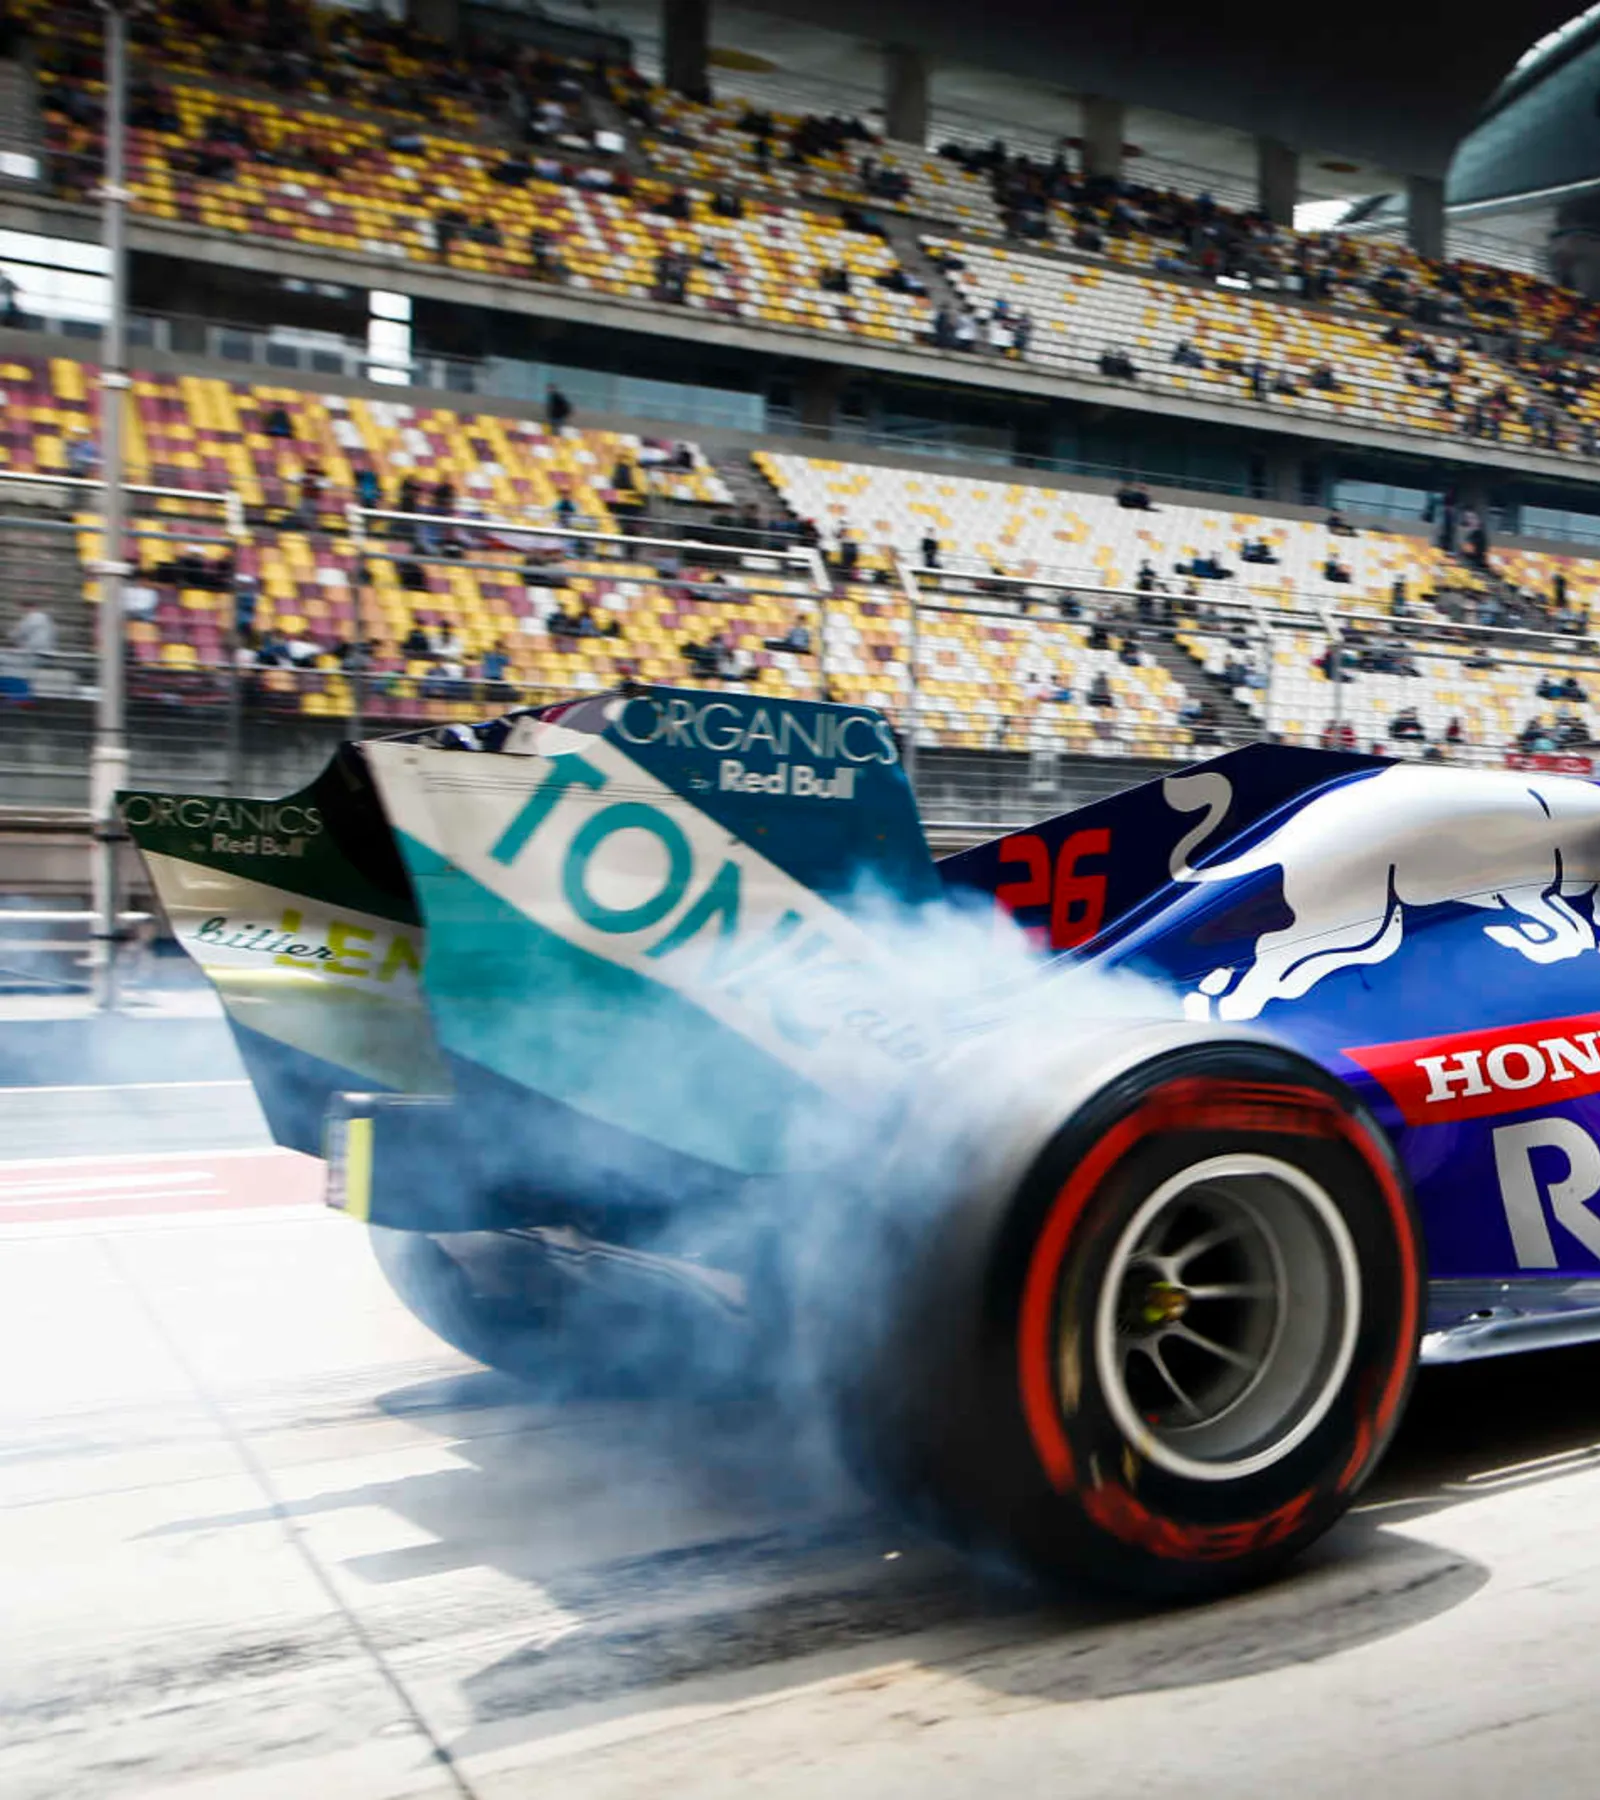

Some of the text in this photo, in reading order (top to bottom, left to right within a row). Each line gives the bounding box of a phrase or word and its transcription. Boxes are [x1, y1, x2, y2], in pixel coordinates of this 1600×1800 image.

[612, 697, 899, 766] ORGANICS
[718, 759, 790, 796] Red
[791, 764, 857, 800] Bull
[124, 795, 323, 836] ORGANICS
[211, 832, 260, 855] Red
[261, 836, 305, 857] Bull
[994, 827, 1112, 951] 26
